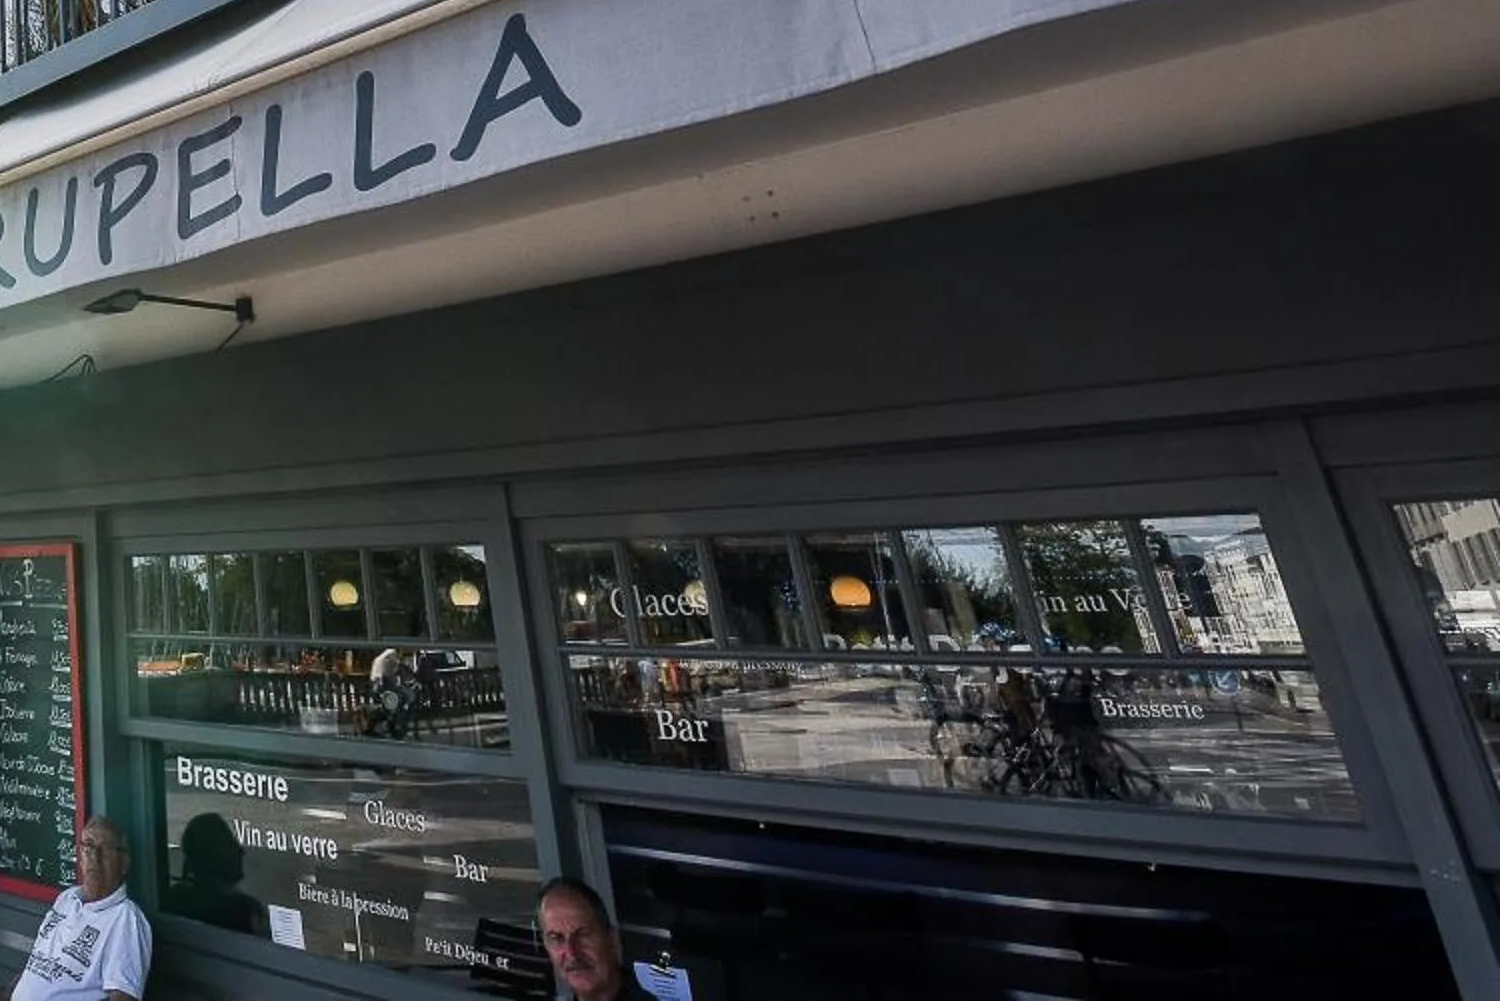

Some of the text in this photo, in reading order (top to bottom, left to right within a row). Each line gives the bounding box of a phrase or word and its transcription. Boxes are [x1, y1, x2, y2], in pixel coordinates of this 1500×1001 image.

[1041, 590, 1068, 613] in
[1075, 593, 1108, 612] au
[1100, 698, 1205, 720] Brasserie
[655, 709, 709, 743] Bar
[177, 756, 289, 801] Brasserie
[364, 800, 427, 833] Glaces
[233, 818, 339, 860] Vin au verre
[454, 854, 490, 883] Bar
[341, 890, 353, 910] la
[354, 895, 409, 920] pression
